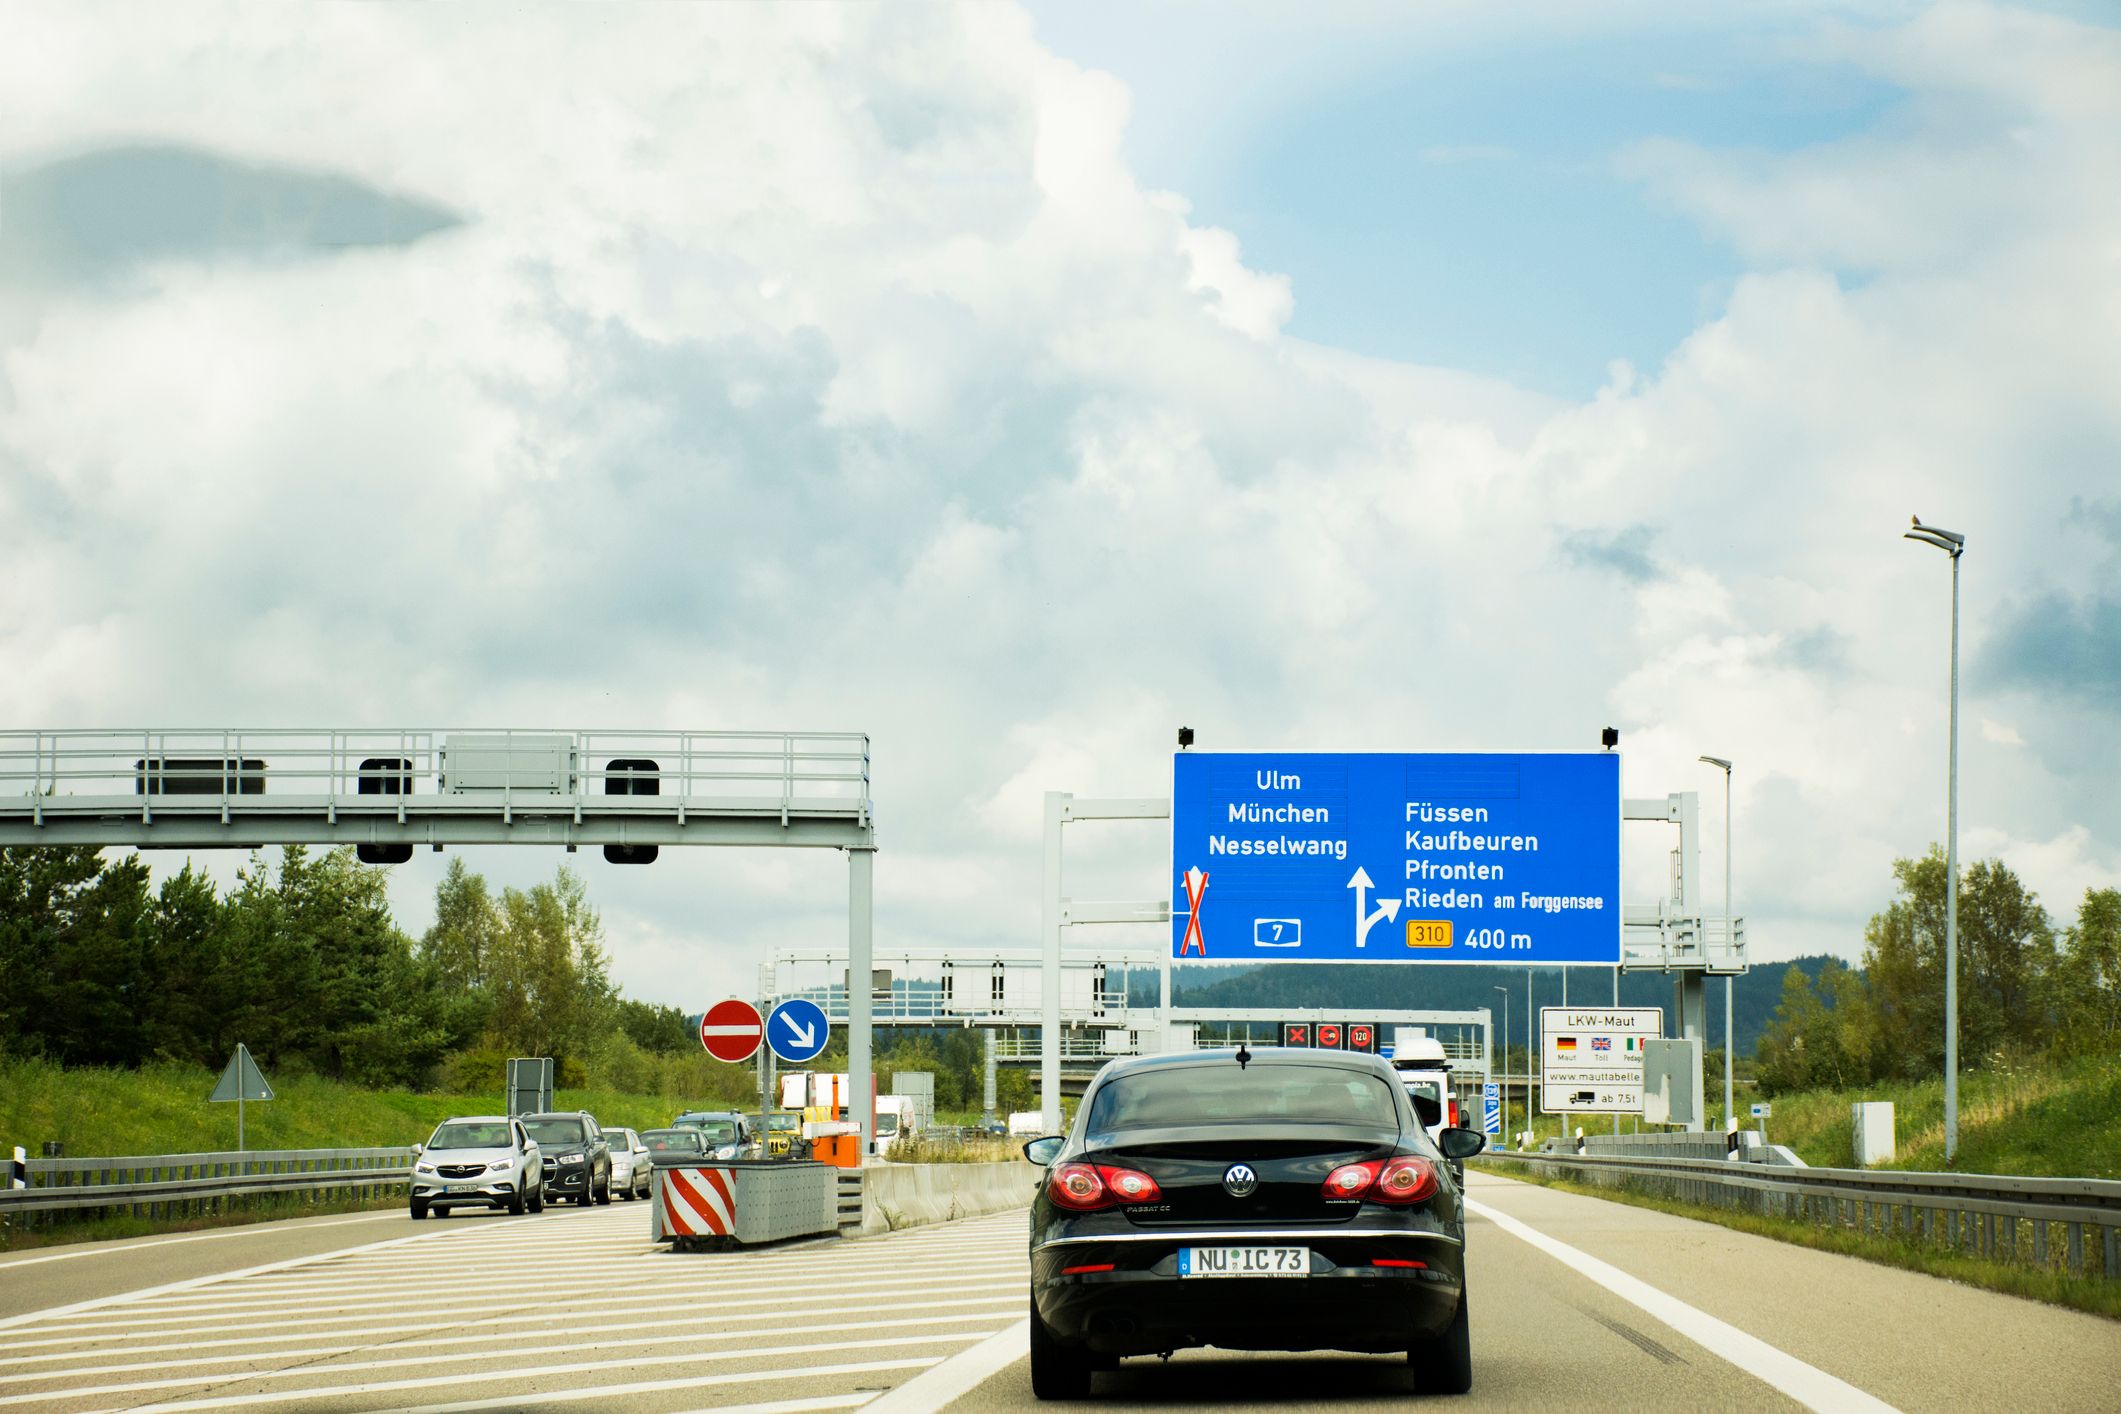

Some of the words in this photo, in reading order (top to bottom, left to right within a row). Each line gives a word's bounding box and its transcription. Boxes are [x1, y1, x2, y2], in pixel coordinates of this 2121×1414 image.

[1256, 770, 1301, 790] Ulm
[1228, 802, 1329, 823] München
[1405, 802, 1489, 823] Füssen
[1209, 835, 1348, 861] Nesselwang
[1405, 830, 1539, 852] Kaufbeuren
[1405, 859, 1504, 880] Pfronten
[1405, 887, 1483, 909] Rieden
[1493, 895, 1515, 909] am
[1521, 891, 1604, 913] Forggensee
[1272, 924, 1283, 941] 7
[1415, 925, 1445, 942] 310
[1464, 928, 1505, 949] 400
[1510, 933, 1532, 949] m
[1567, 1015, 1635, 1027] LKW-Maut
[1354, 1032, 1367, 1042] 120
[1557, 1054, 1577, 1062] Maut
[1594, 1054, 1609, 1062] Toll
[1601, 1094, 1614, 1103] ab
[1198, 1249, 1227, 1271] NU
[1243, 1249, 1270, 1270] IC
[1274, 1249, 1302, 1270] 73
